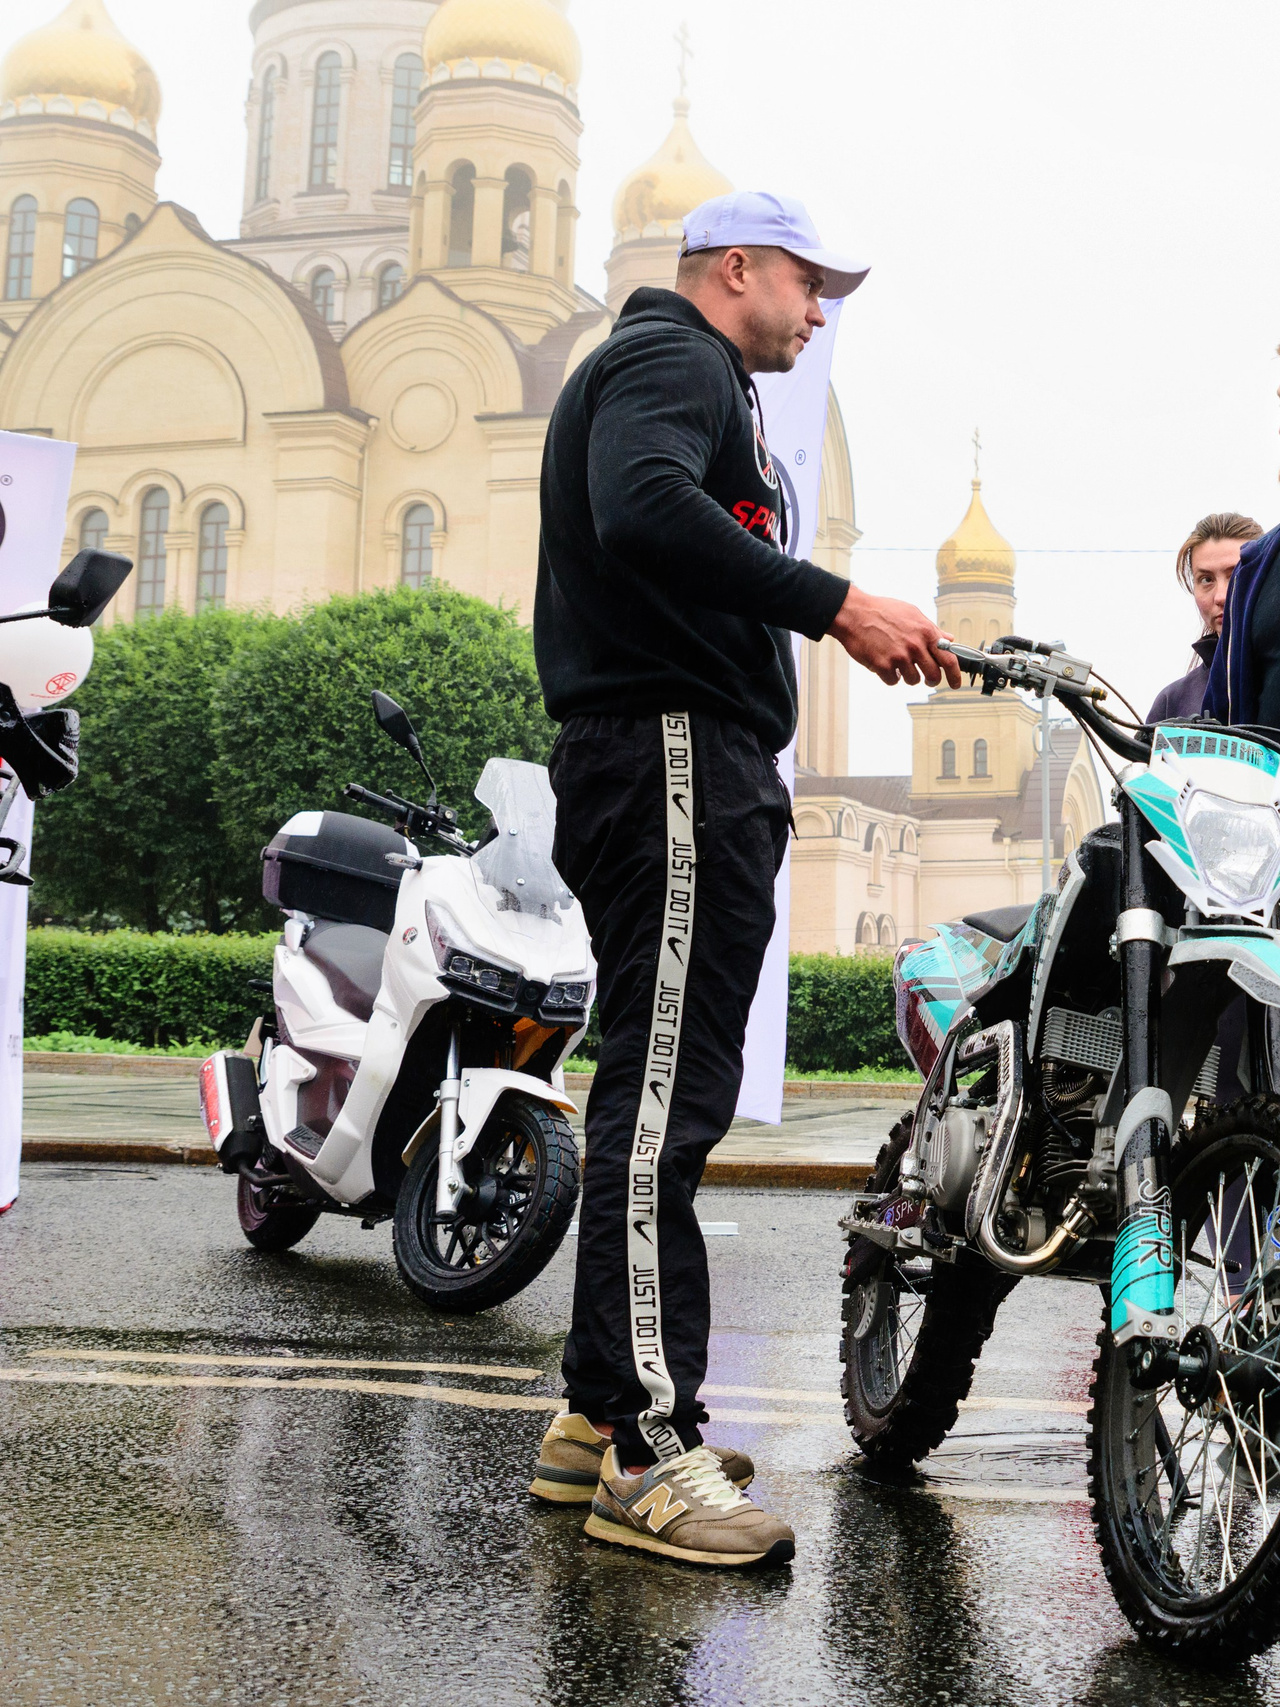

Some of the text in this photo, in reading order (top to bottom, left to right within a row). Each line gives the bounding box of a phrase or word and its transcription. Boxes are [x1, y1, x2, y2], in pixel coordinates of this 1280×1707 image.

[668, 747, 689, 769] DO
[670, 774, 689, 789] IT
[667, 837, 692, 934] JUST DO IT
[650, 980, 680, 1078] JUST DO IT
[632, 1123, 660, 1216] JUST DO IT
[1137, 1177, 1173, 1269] SPR
[633, 1264, 660, 1357] JUST DO IT
[646, 1422, 673, 1446] DO
[659, 1442, 683, 1457] IT
